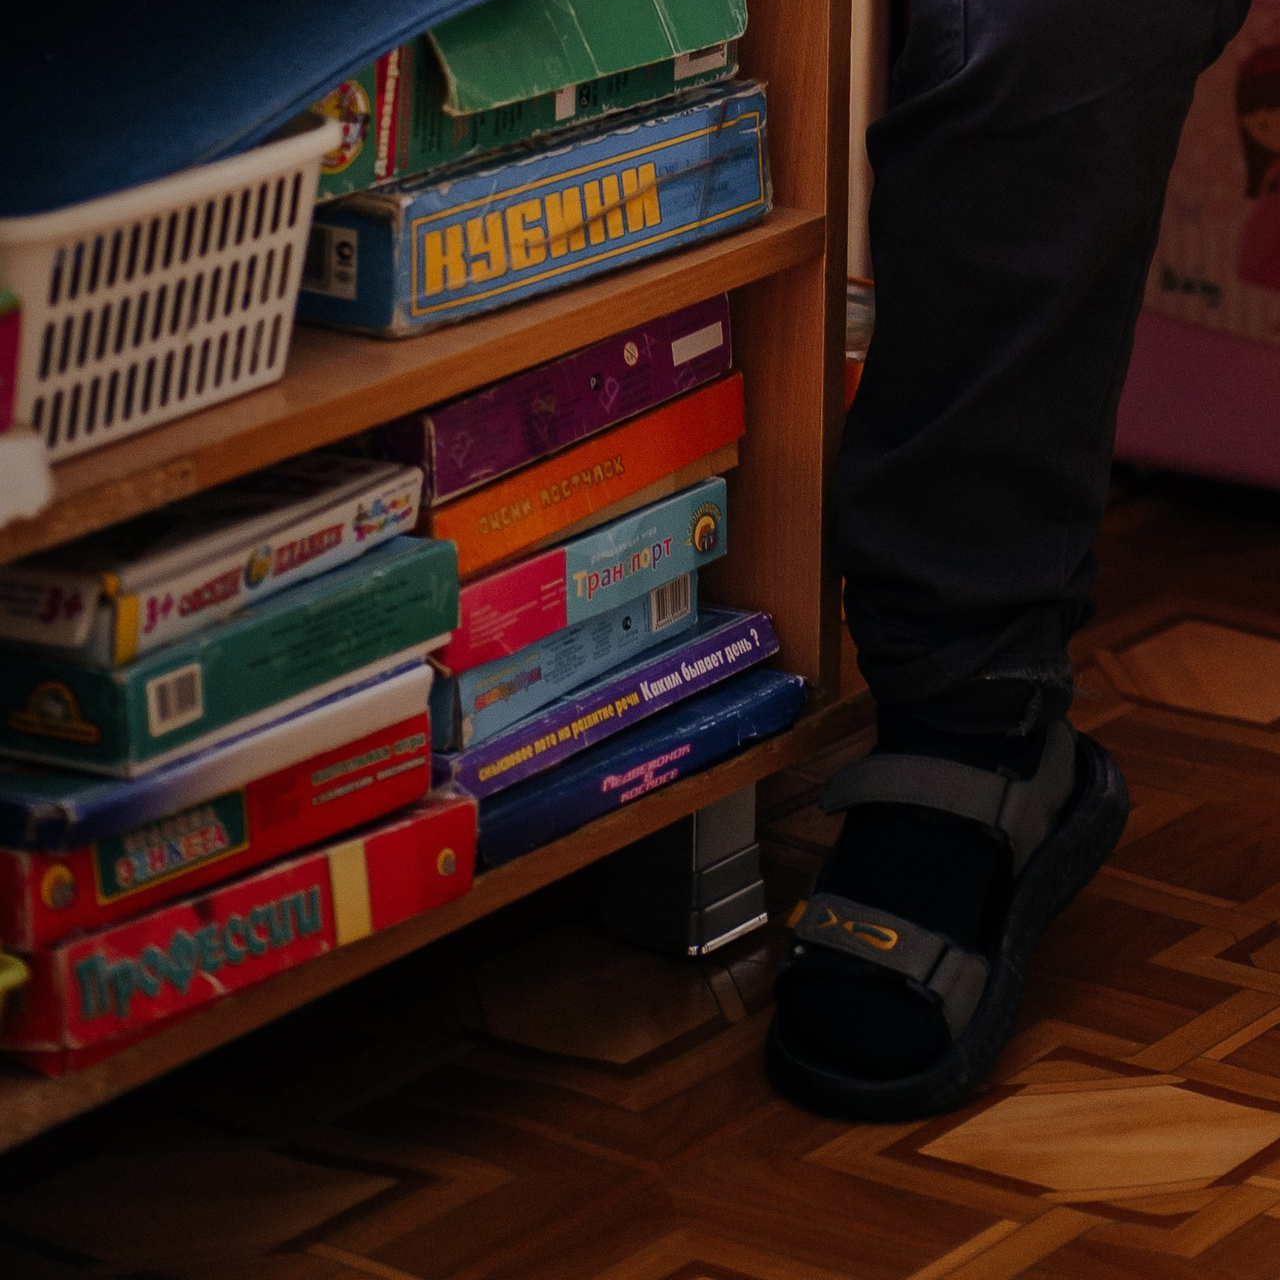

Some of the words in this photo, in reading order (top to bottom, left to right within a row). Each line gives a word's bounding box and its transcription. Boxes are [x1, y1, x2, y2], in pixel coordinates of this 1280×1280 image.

[573, 537, 673, 601] Транспорт
[615, 691, 640, 719] речи
[639, 672, 682, 701] Каким
[681, 651, 724, 682] бывает
[725, 636, 753, 663] день
